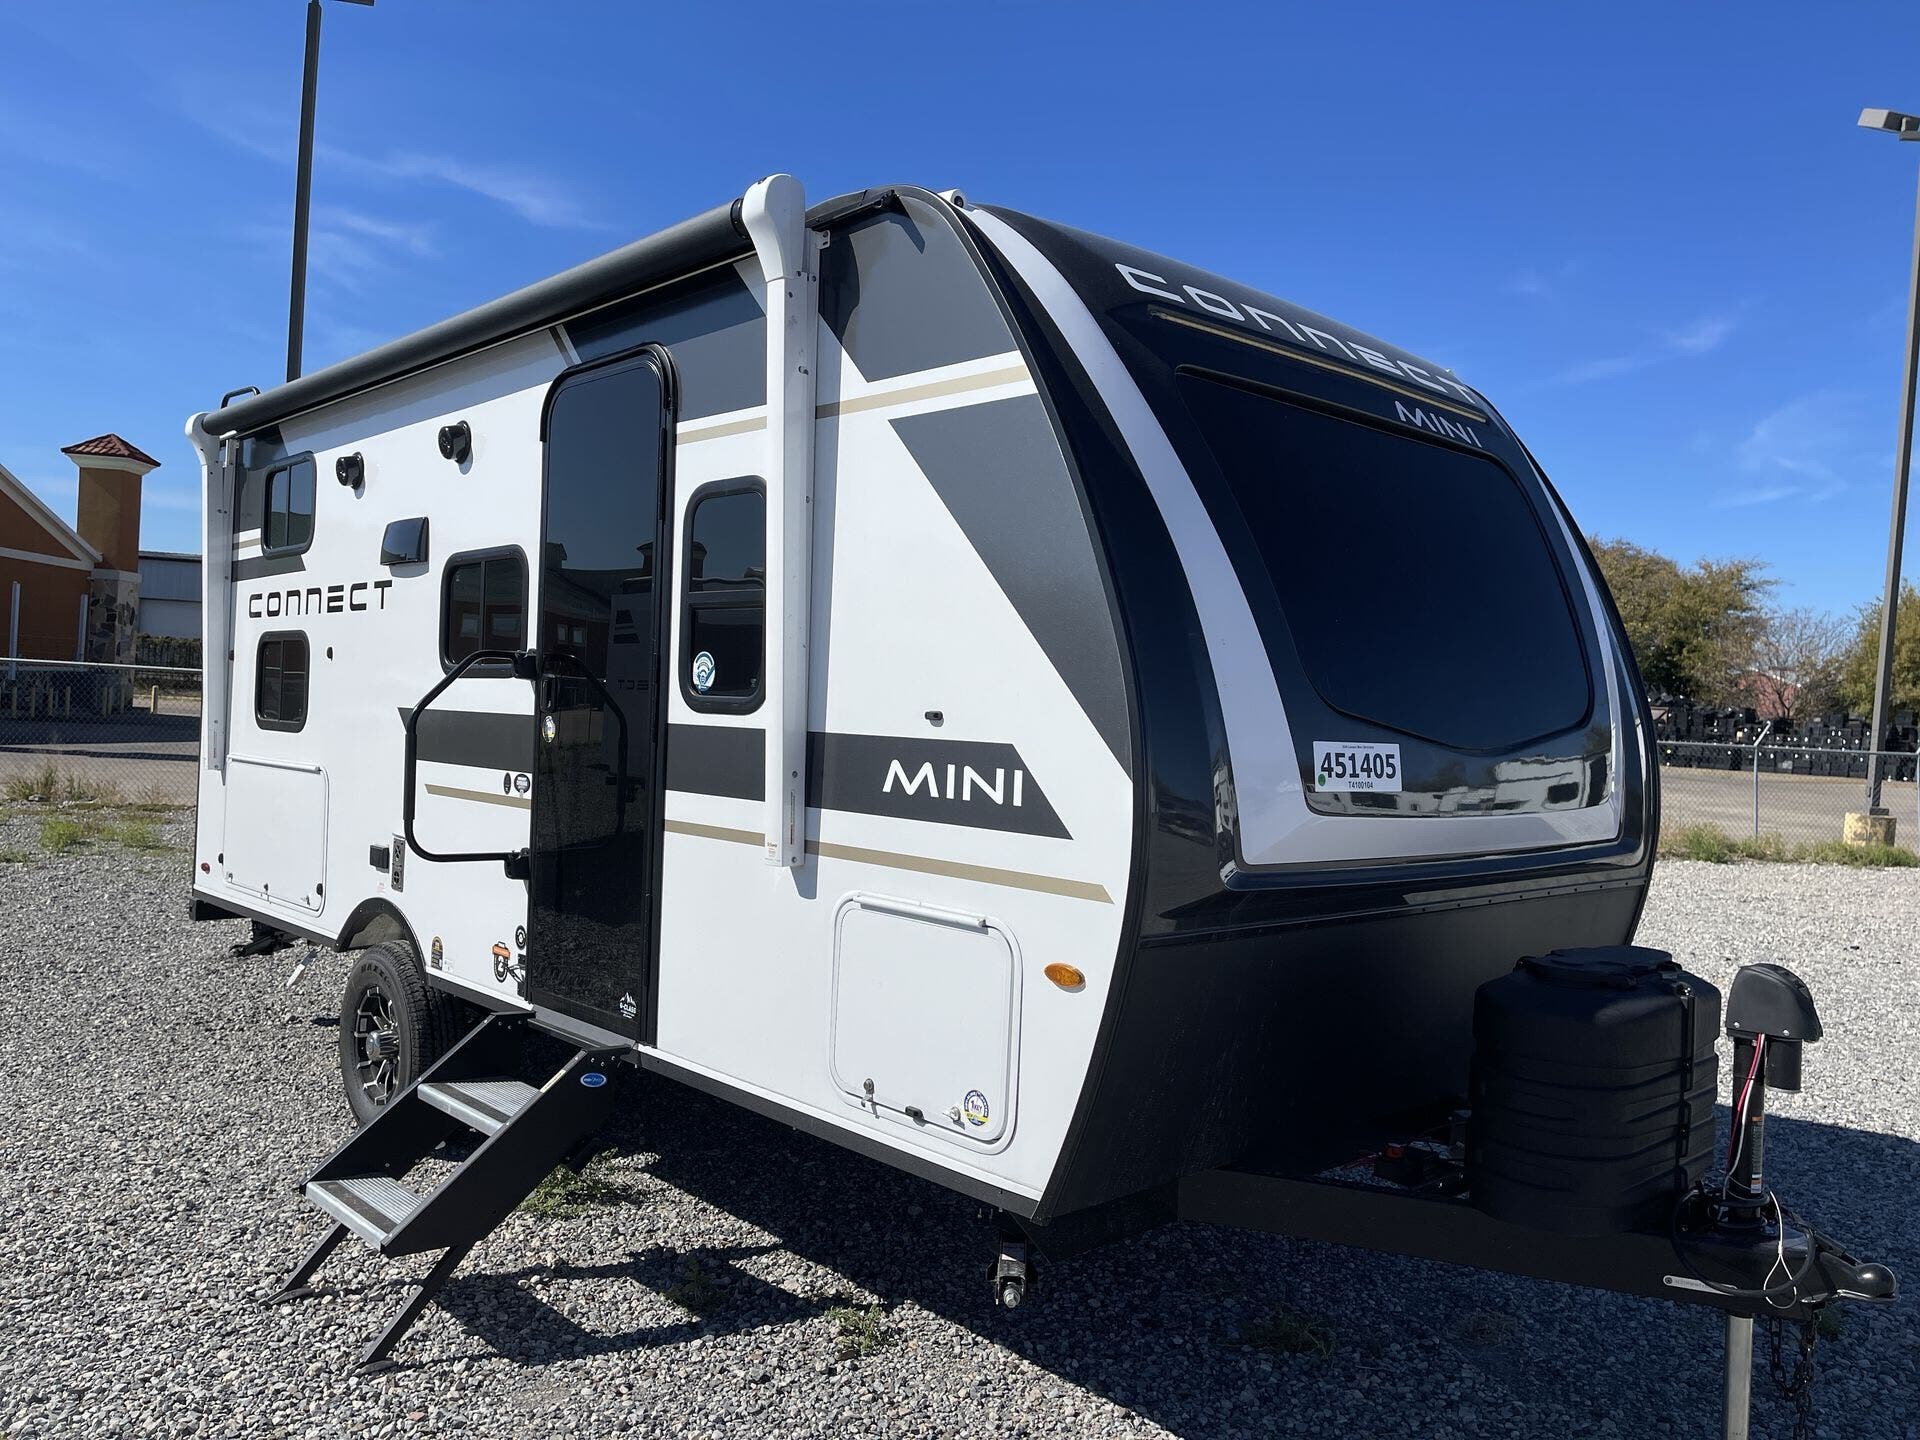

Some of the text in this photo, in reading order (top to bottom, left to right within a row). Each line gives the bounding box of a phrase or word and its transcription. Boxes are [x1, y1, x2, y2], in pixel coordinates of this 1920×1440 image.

[1115, 263, 1476, 404] CONNECT
[1394, 401, 1482, 448] MINI
[249, 580, 393, 619] CONNECT
[882, 759, 1024, 807] MINI
[1320, 752, 1397, 779] 451405
[1348, 781, 1374, 789] T4100104
